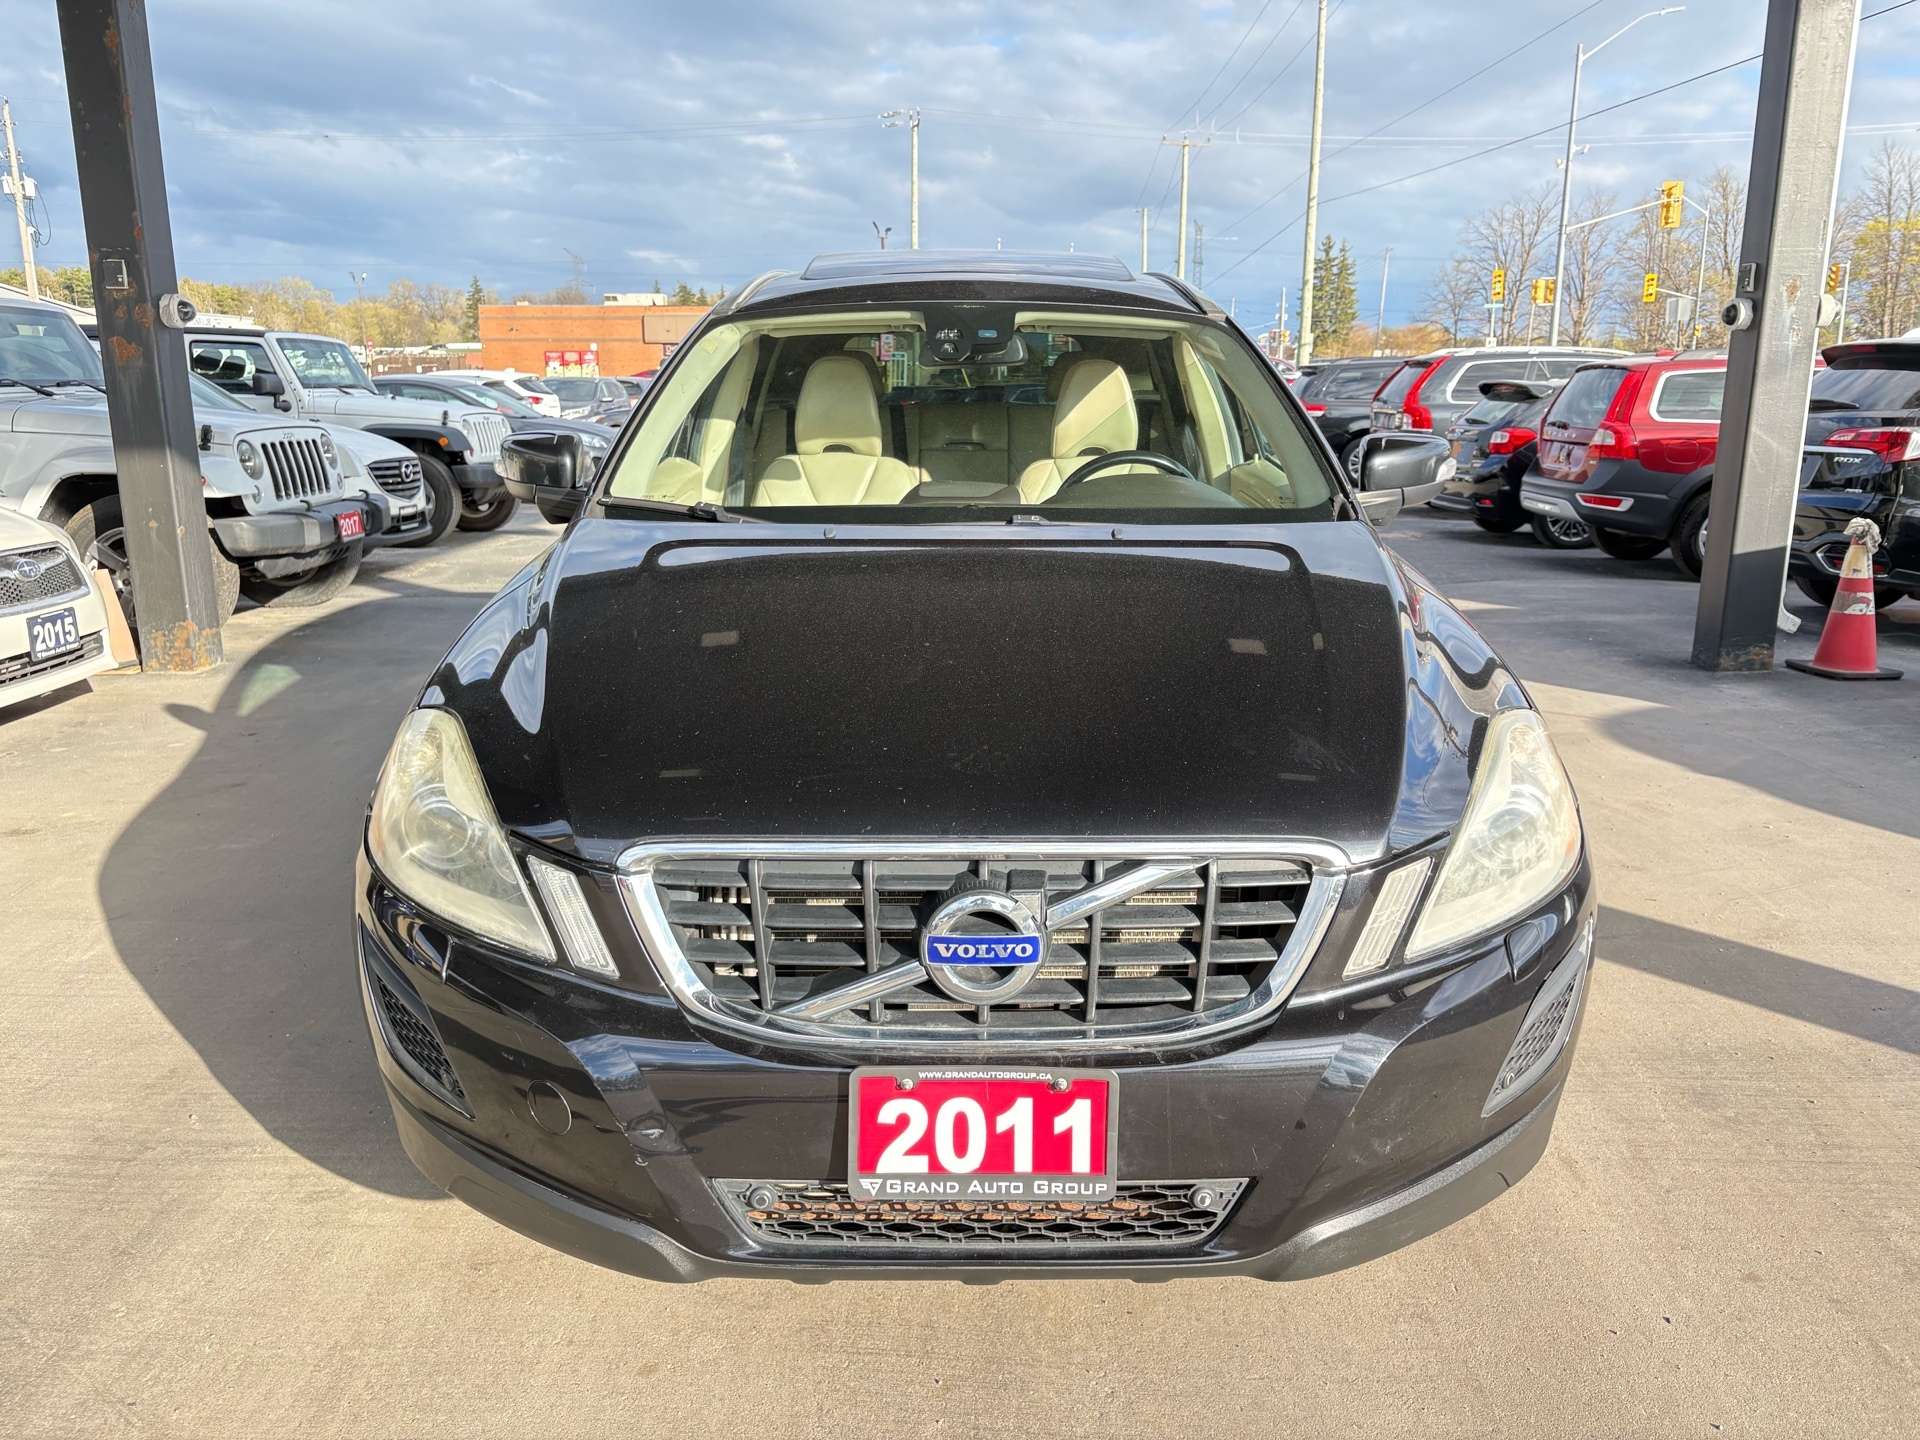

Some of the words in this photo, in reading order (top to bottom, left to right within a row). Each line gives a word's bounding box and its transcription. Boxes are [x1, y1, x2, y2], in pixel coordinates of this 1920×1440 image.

[341, 516, 359, 535] 2017
[33, 617, 76, 652] 2015
[933, 943, 1033, 958] VOLVO
[919, 1071, 1052, 1080] WWW.GRANDAUTOGROUP.CA
[876, 1096, 1091, 1174] 2011
[886, 1179, 959, 1193] GRAND
[968, 1180, 1023, 1194] AUTO
[1034, 1180, 1107, 1195] GROUP
